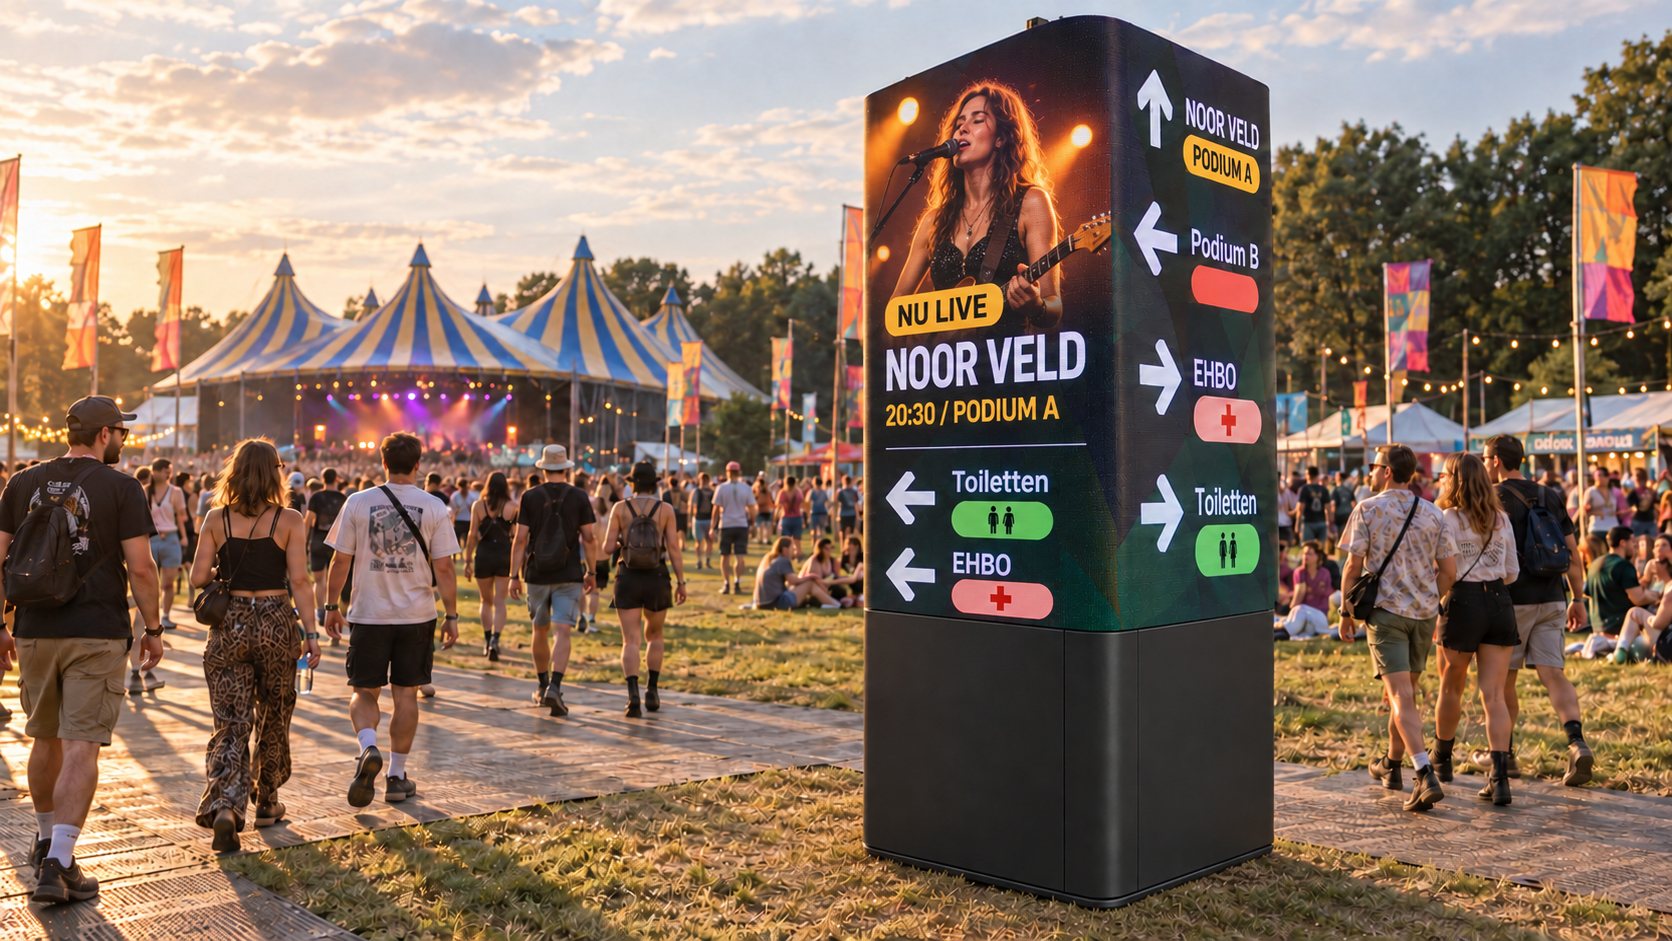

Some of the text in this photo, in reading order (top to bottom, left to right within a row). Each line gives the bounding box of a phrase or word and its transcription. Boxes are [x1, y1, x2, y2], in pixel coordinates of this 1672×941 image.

[1185, 97, 1260, 151] NOOR VELD
[1193, 143, 1253, 185] PODIUM A
[1191, 227, 1259, 270] Podium B
[898, 293, 988, 328] NU LIVE
[885, 331, 1086, 392] NOOR VELD
[1193, 358, 1237, 391] EHBO
[885, 395, 1060, 427] 20:30 / PODIUM A
[951, 469, 1049, 493] Toiletten
[1194, 486, 1257, 516] Toiletten
[952, 551, 1012, 577] EHBO
